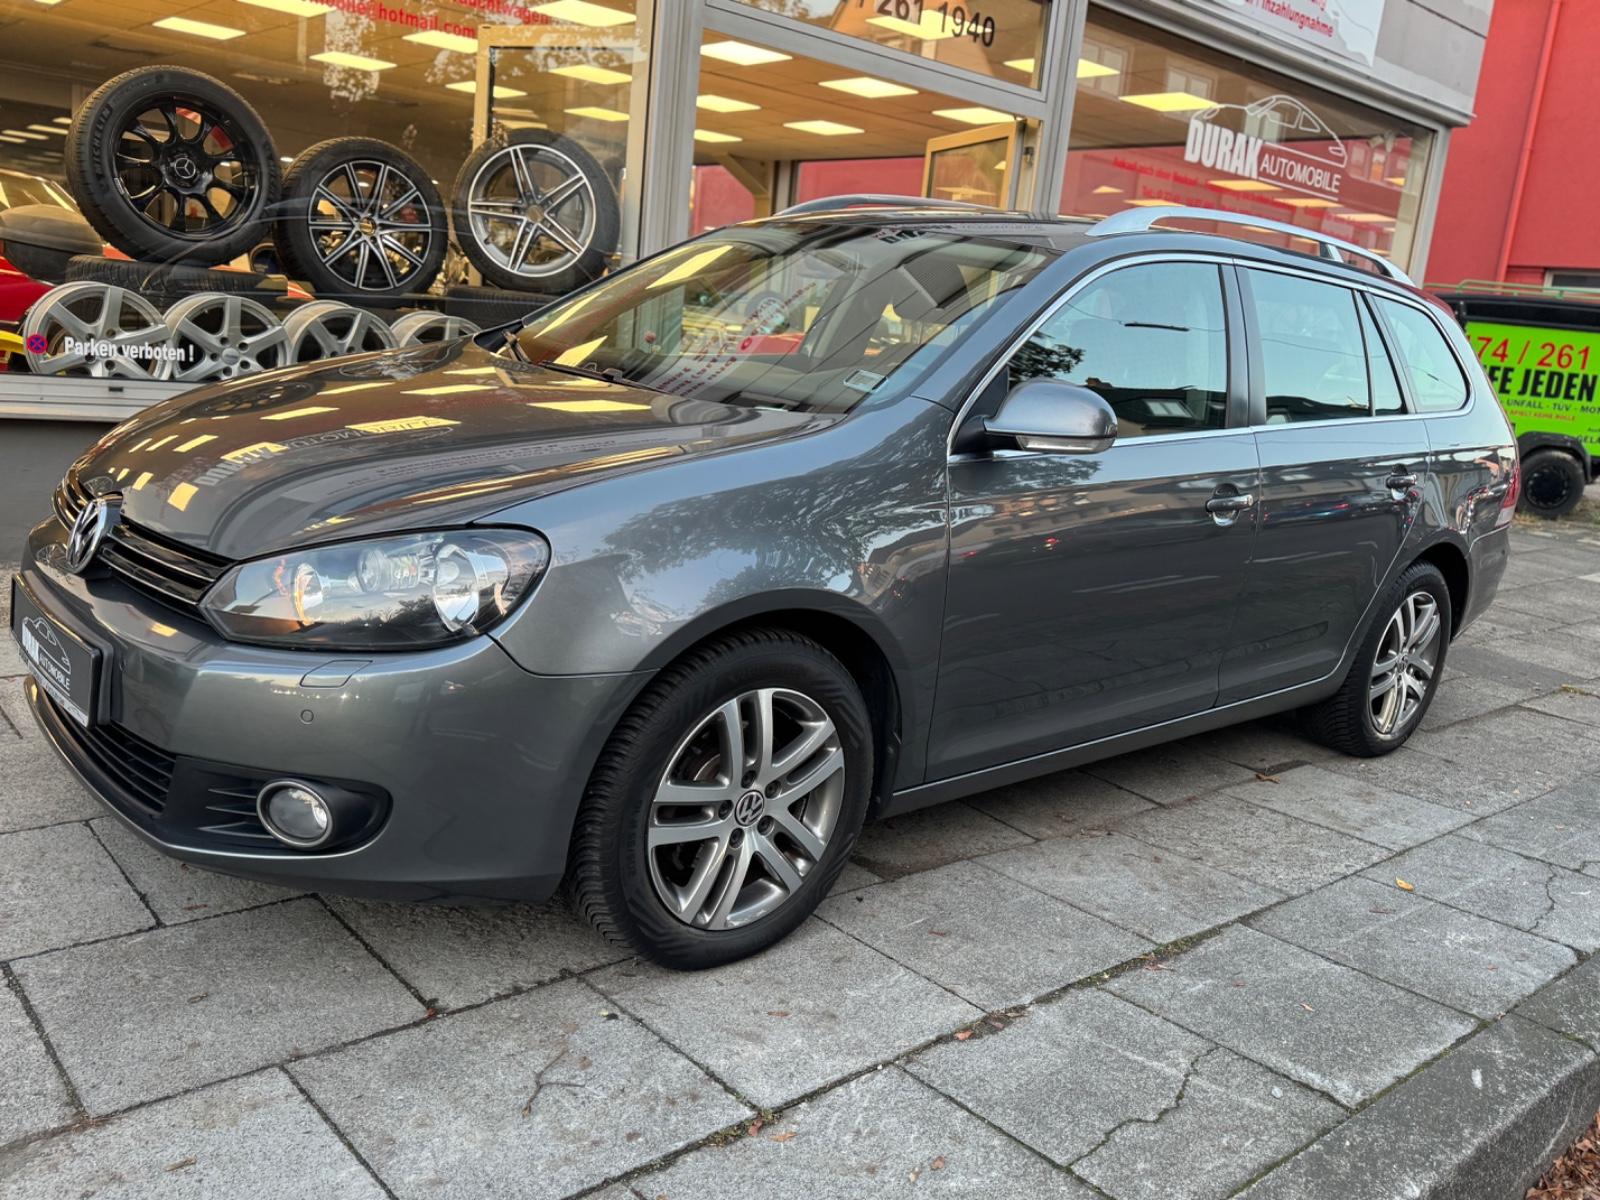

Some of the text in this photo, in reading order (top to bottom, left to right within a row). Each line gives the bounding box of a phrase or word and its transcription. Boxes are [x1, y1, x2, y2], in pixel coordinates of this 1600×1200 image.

[937, 1, 995, 47] 1940
[1184, 118, 1264, 180] DURAK
[1260, 153, 1342, 193] AUTOMOBILE
[64, 336, 195, 363] Parken verboten !
[1467, 335, 1510, 363] 74
[1537, 341, 1590, 371] 261
[1483, 365, 1598, 402] FE JEDEN
[1506, 398, 1543, 410] UNFALL
